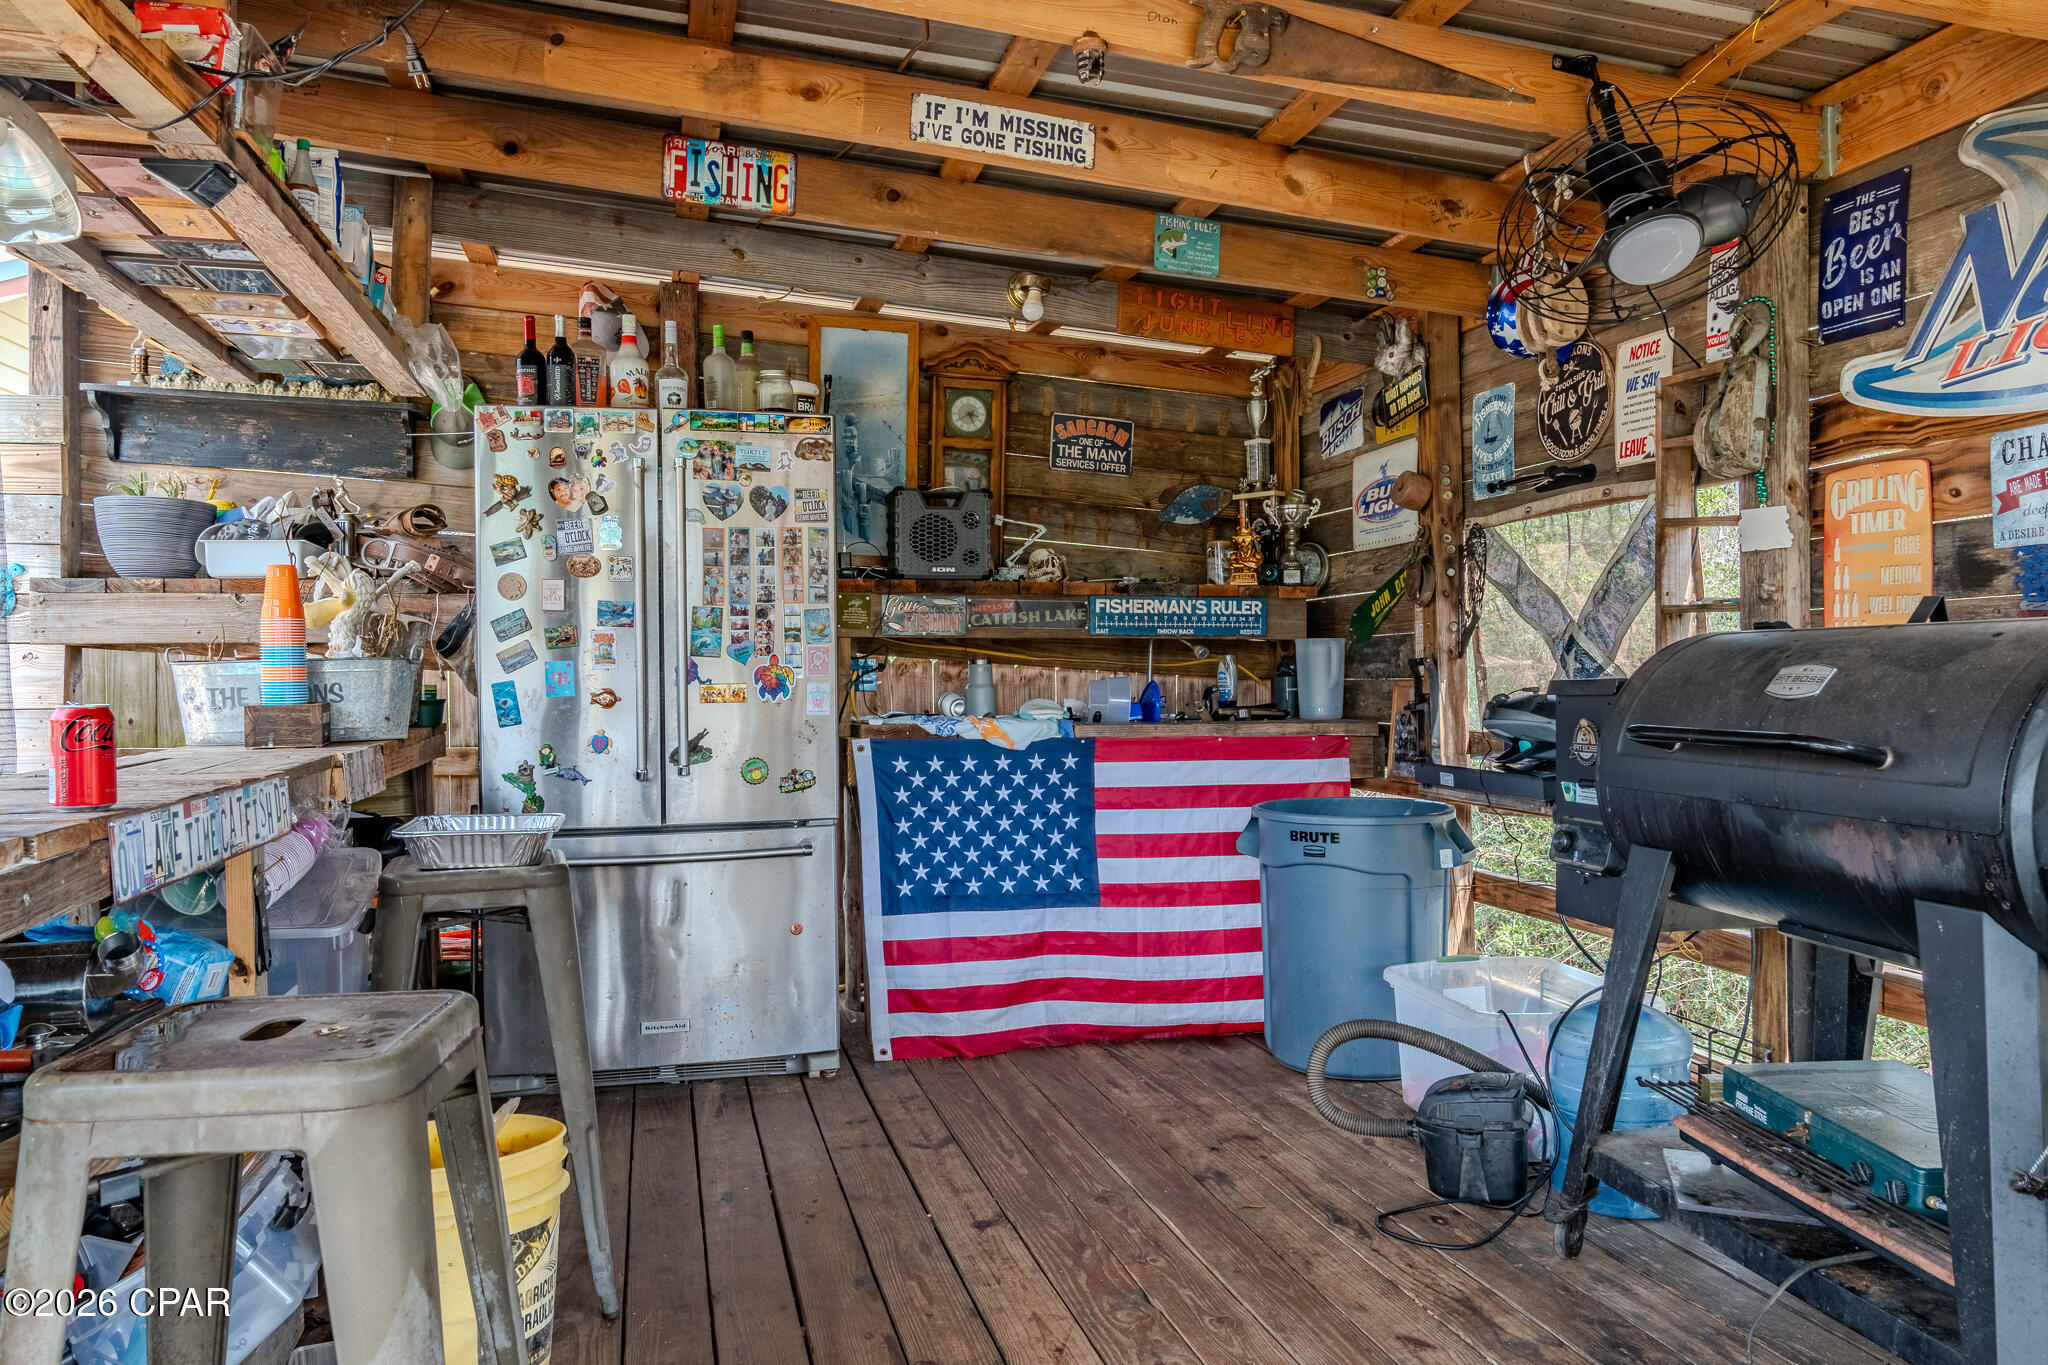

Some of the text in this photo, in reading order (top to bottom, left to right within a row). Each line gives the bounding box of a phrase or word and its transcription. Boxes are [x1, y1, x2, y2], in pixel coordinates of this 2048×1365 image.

[925, 102, 1083, 144] IF I'M MISSING
[919, 122, 1086, 164] I'VE GONE FISHING
[670, 148, 788, 204] FISHING
[1856, 190, 1876, 207] THE
[1849, 199, 1900, 235] BEST
[1822, 222, 1902, 290] Beer
[1860, 258, 1900, 286] IS AN
[1822, 281, 1901, 320] OPEN ONE
[1135, 286, 1292, 338] TIGHT LINE
[1141, 312, 1264, 346] JUNKIES
[1570, 345, 1592, 356] XONS
[1628, 338, 1662, 362] NOTICE
[1558, 370, 1586, 392] POOLSIDE
[1626, 371, 1660, 393] WE SAY
[1540, 370, 1606, 424] Chill & Grill
[1322, 399, 1362, 449] BUSCH
[1474, 400, 1513, 426] FISHERMAN
[1055, 419, 1130, 447] SARCASM
[1079, 438, 1093, 446] ONE
[1328, 425, 1354, 458] LIGHT
[1580, 434, 1595, 452] GOOD
[1057, 444, 1126, 462] THE MANY
[1473, 435, 1512, 462] LIVES HERE
[1620, 436, 1648, 460] LEAVE
[1056, 458, 1095, 469] SERVICES
[1101, 462, 1126, 473] OFFER
[803, 490, 820, 499] BEER
[1366, 484, 1392, 502] BU
[1830, 470, 1925, 520] GRILLING
[2009, 480, 2022, 496] ARE
[2024, 475, 2042, 494] MADE
[803, 501, 827, 512] O'CLOCK
[1358, 499, 1400, 516] LIGH
[564, 520, 583, 530] BEER
[1848, 508, 1906, 534] TIMER
[565, 531, 591, 543] O'CLOCK
[2000, 526, 2045, 541] A DESIRE
[1894, 535, 1921, 555] RARE
[1880, 565, 1922, 585] MEDIUM
[1095, 599, 1262, 615] FISHERMAN'S RULER
[1371, 589, 1390, 617] JOHN
[1869, 596, 1894, 615] WELL
[971, 608, 1087, 626] CATFISH LAKE
[207, 682, 344, 708] THE ONS
[60, 755, 66, 768] ME
[118, 838, 140, 897] ON
[142, 811, 182, 879] LAKE
[185, 812, 219, 868] TIME
[220, 788, 274, 852] CATFISH
[1290, 830, 1340, 844] BRUTE
